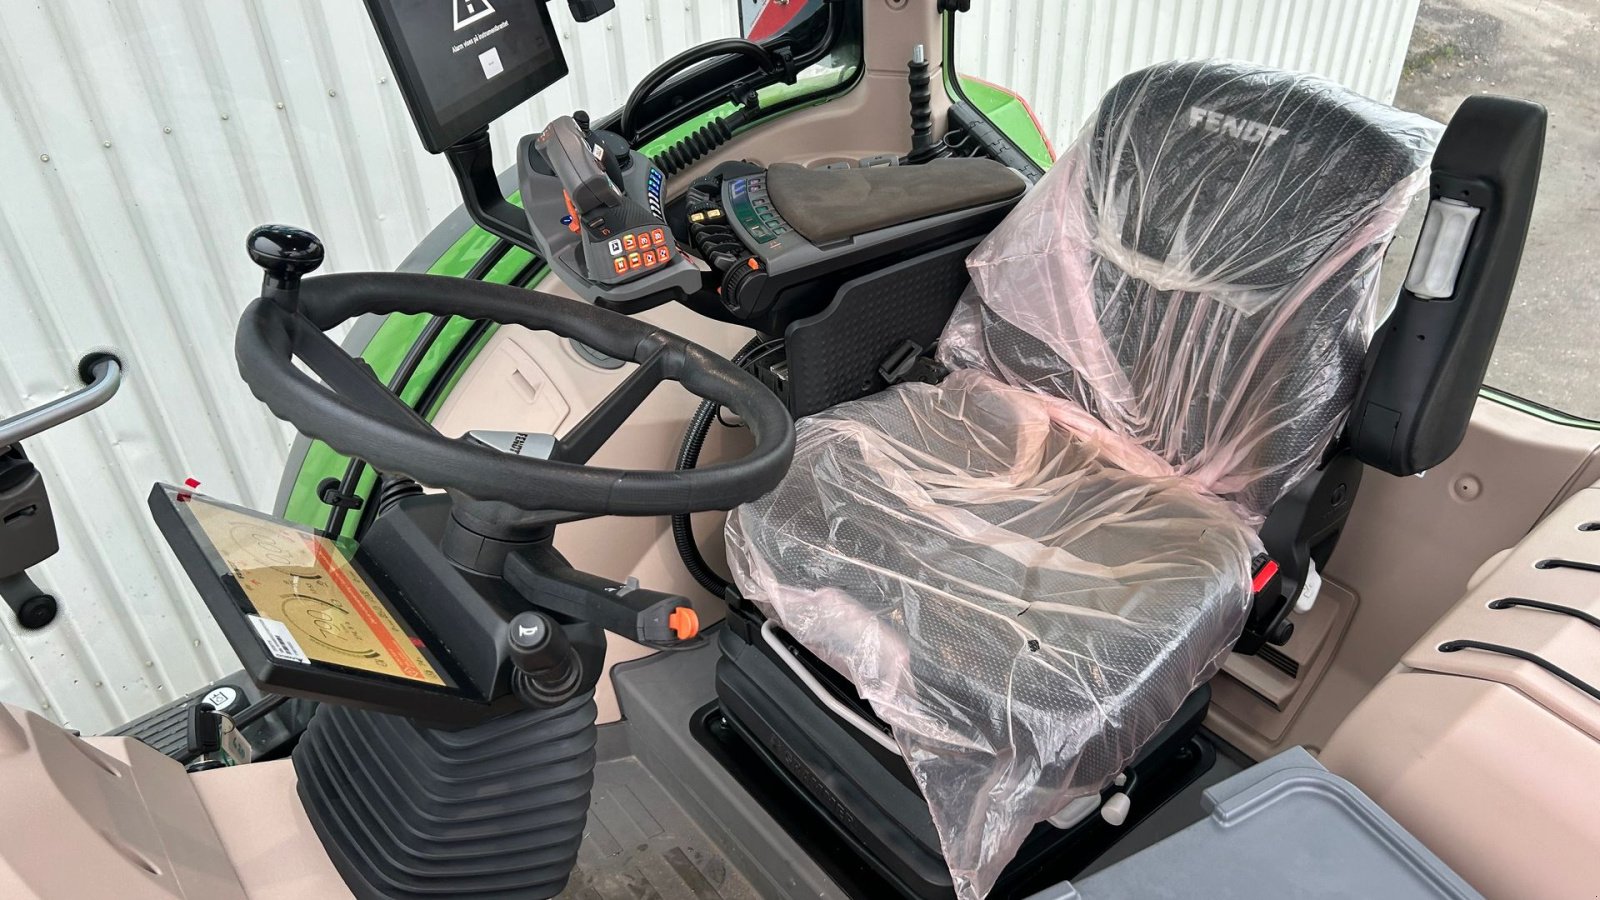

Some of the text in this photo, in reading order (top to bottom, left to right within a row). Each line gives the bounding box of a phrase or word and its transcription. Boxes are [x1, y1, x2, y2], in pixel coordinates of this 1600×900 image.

[452, 44, 464, 53] Alarm
[1189, 106, 1290, 147] FENDT
[509, 432, 529, 455] FENDT
